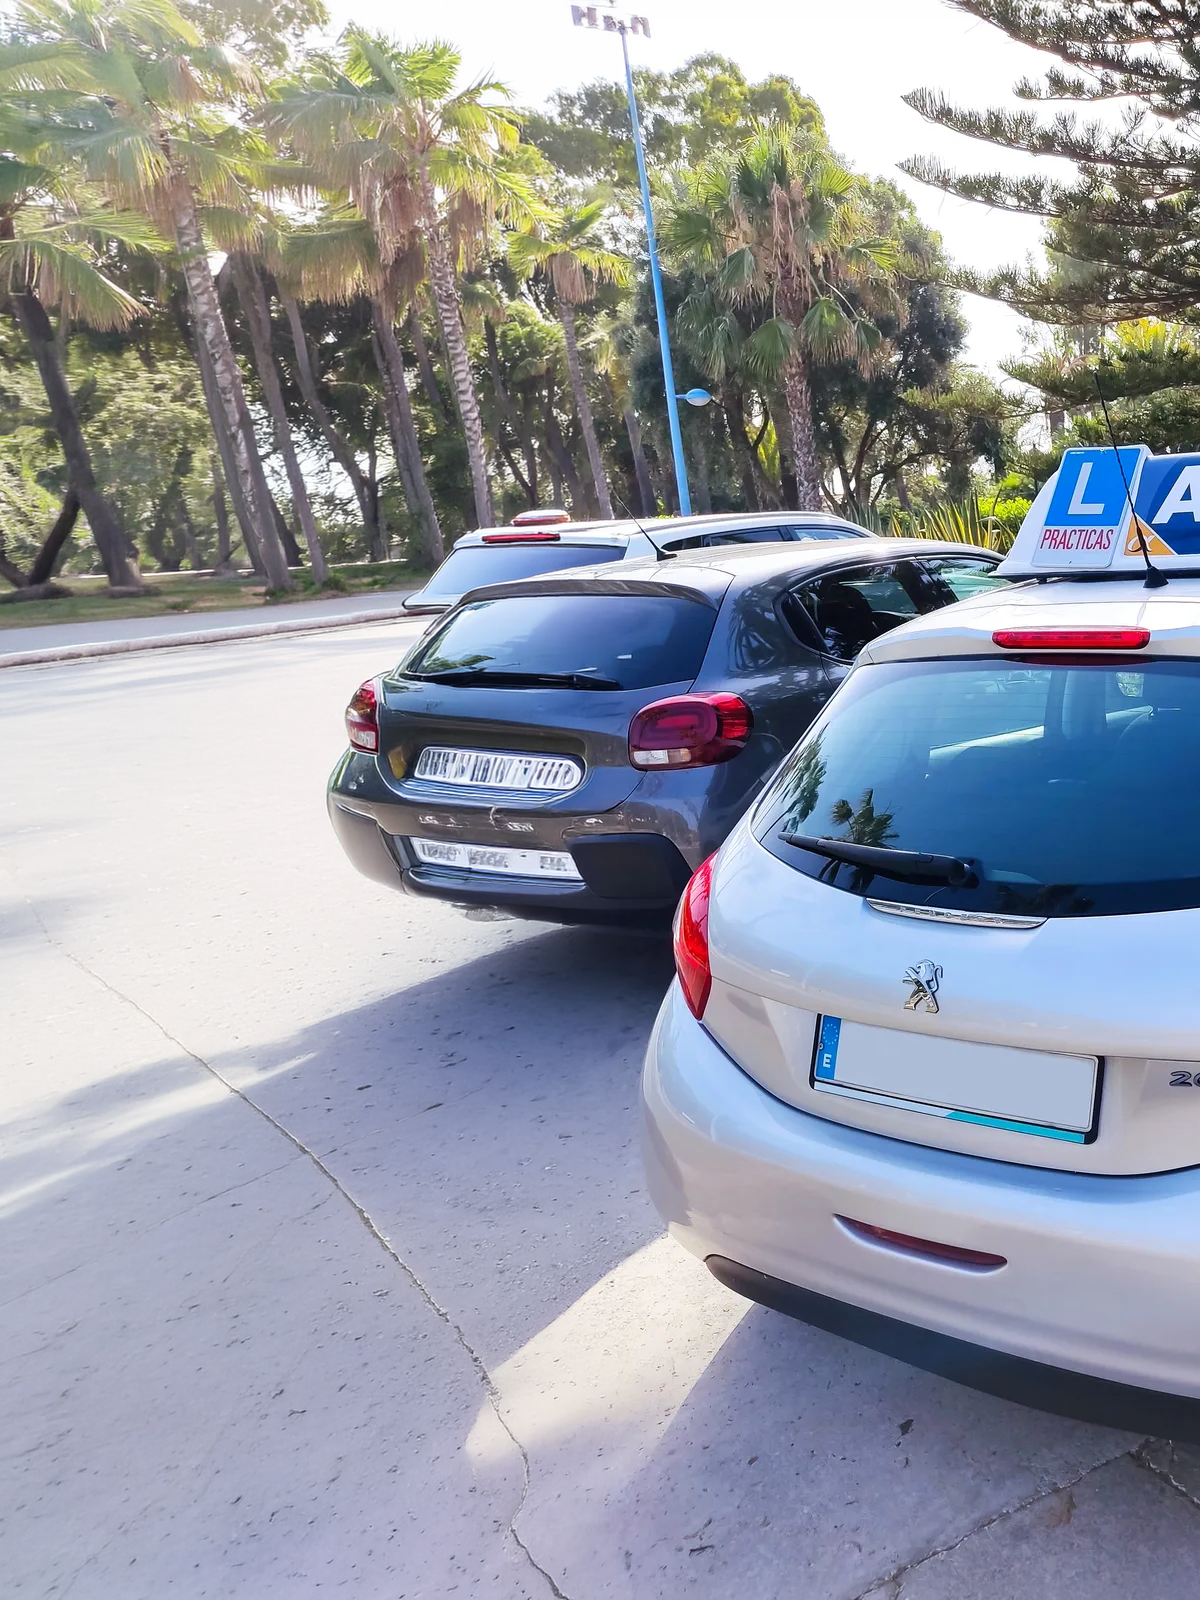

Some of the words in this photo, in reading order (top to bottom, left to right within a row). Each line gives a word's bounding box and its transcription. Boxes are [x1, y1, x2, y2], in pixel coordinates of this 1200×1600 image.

[1067, 462, 1105, 515] L
[1040, 529, 1114, 550] PRACTICAS
[822, 1053, 832, 1068] E
